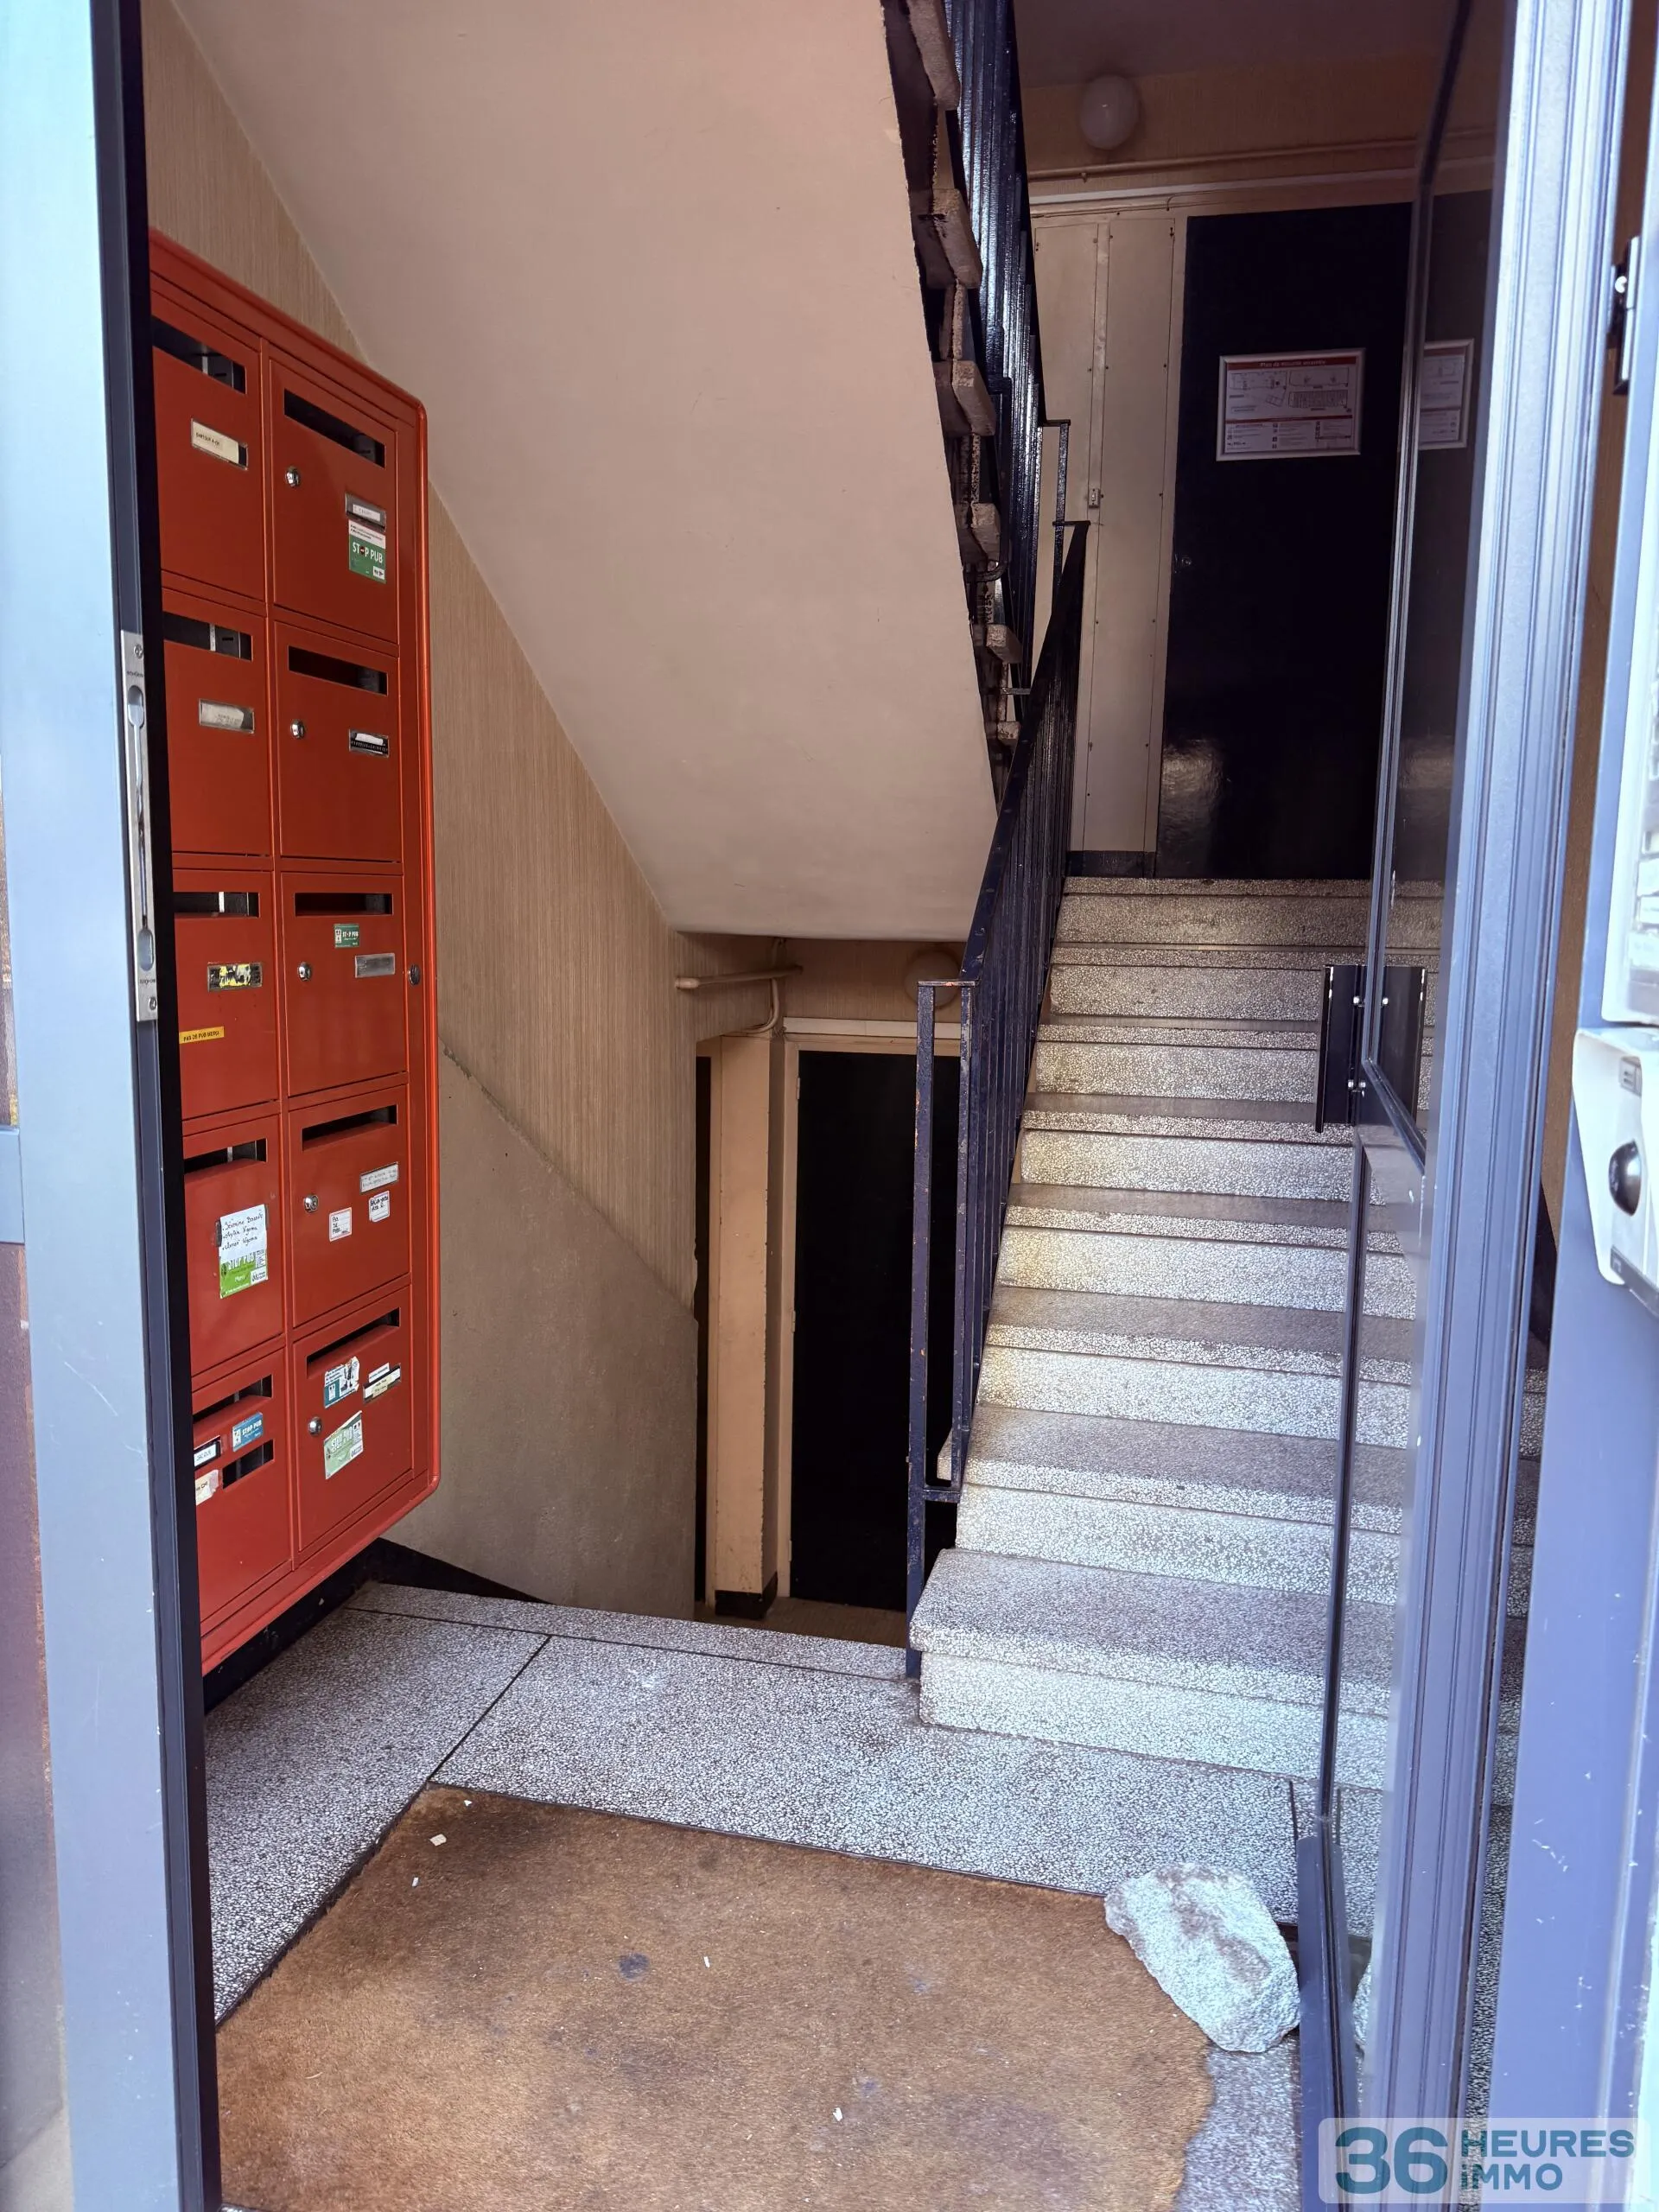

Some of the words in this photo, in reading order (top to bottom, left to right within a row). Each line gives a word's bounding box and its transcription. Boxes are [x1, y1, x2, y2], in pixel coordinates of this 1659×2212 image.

[353, 541, 369, 557] STOP
[370, 550, 383, 563] PUB
[242, 1425, 252, 1436] STOP
[253, 1420, 262, 1429] PUB
